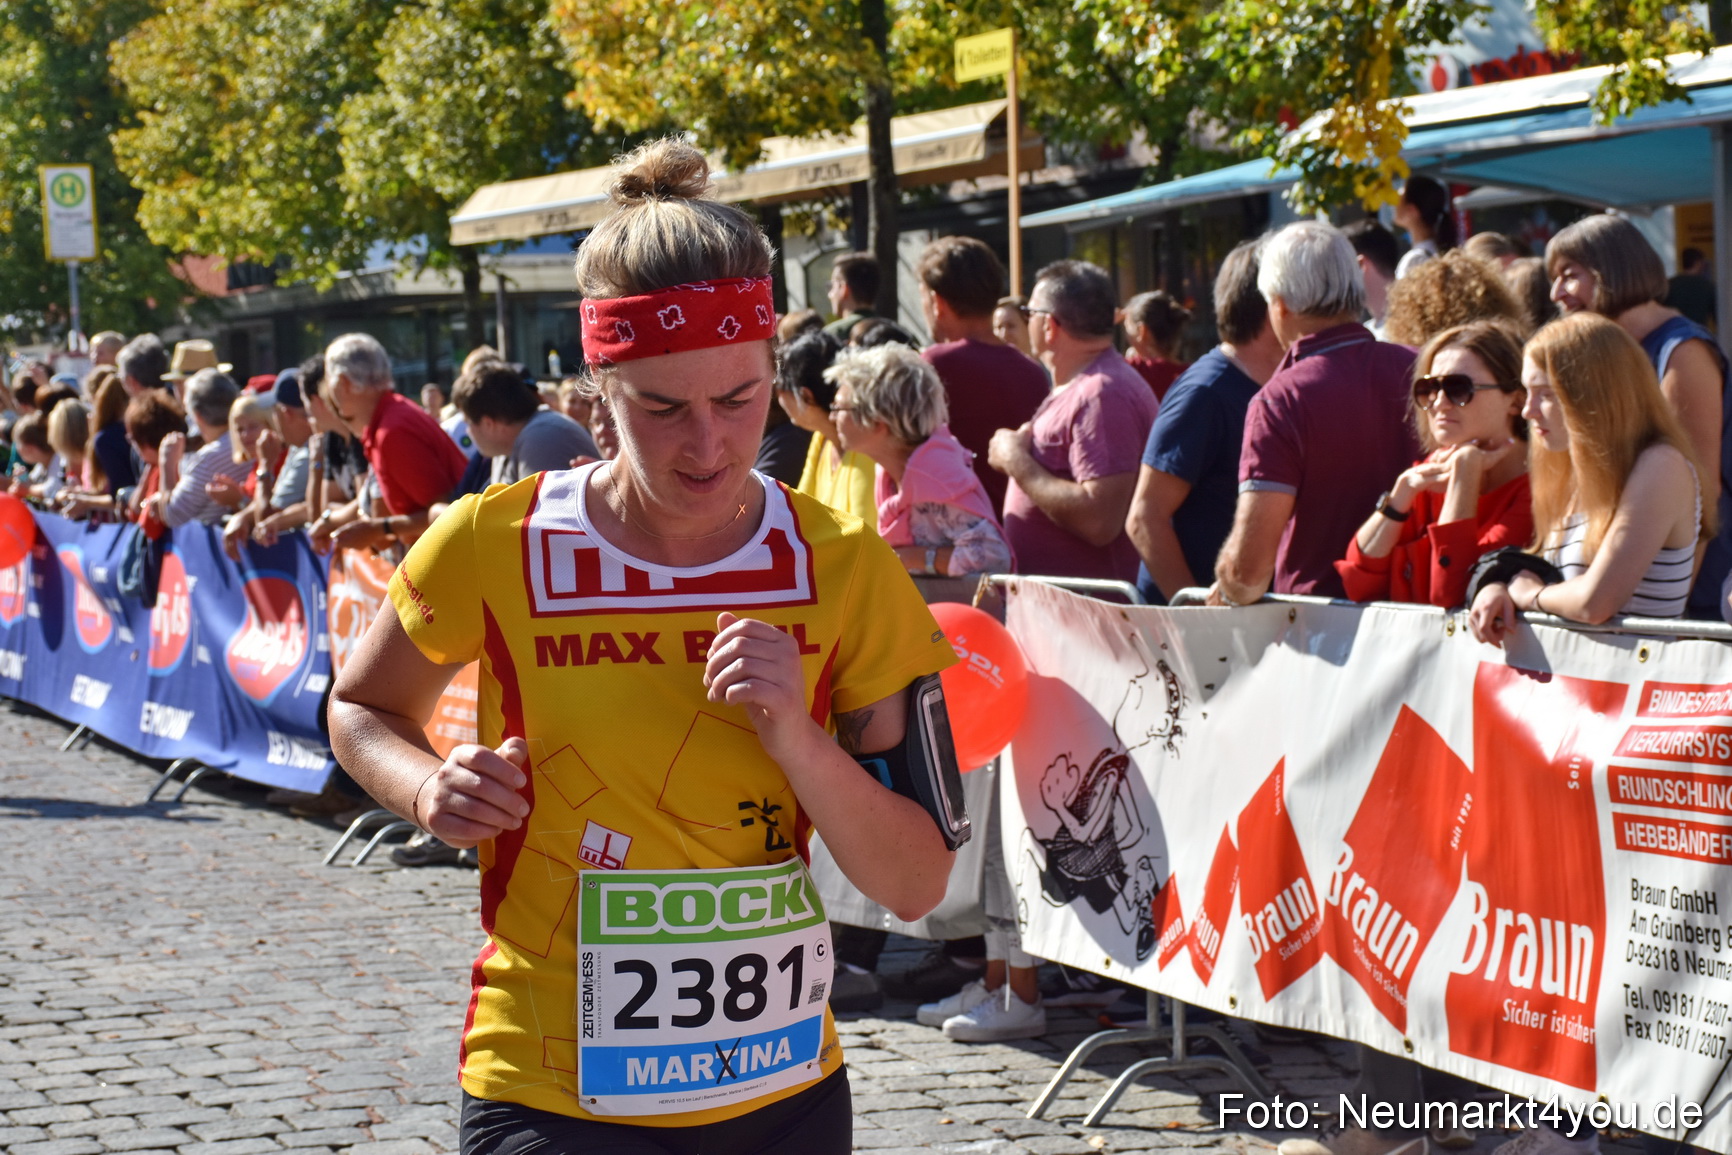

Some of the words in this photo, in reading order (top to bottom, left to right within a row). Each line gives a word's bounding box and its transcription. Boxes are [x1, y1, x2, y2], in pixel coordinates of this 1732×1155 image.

[533, 631, 667, 668] MAX
[683, 622, 822, 664] BL
[1626, 731, 1732, 760] VERZURRSYS
[1457, 793, 1474, 824] 1929
[600, 869, 816, 935] BOCK
[1324, 840, 1420, 980] Braun
[1631, 878, 1667, 908] Braun
[1670, 886, 1719, 916] GmbH
[1241, 876, 1316, 966] Braun
[1450, 879, 1595, 1004] Braun
[1629, 909, 1648, 935] Am
[1651, 913, 1722, 953] Grünberg
[1626, 939, 1680, 973] D-92318
[613, 944, 805, 1030] 2381
[1623, 983, 1650, 1011] Tel.
[1653, 989, 1695, 1019] 09181
[1502, 998, 1548, 1031] Sicher
[1550, 1009, 1567, 1034] ist
[1566, 1013, 1595, 1045] sicher
[1624, 1014, 1652, 1041] Fax
[1656, 1020, 1691, 1051] 09181
